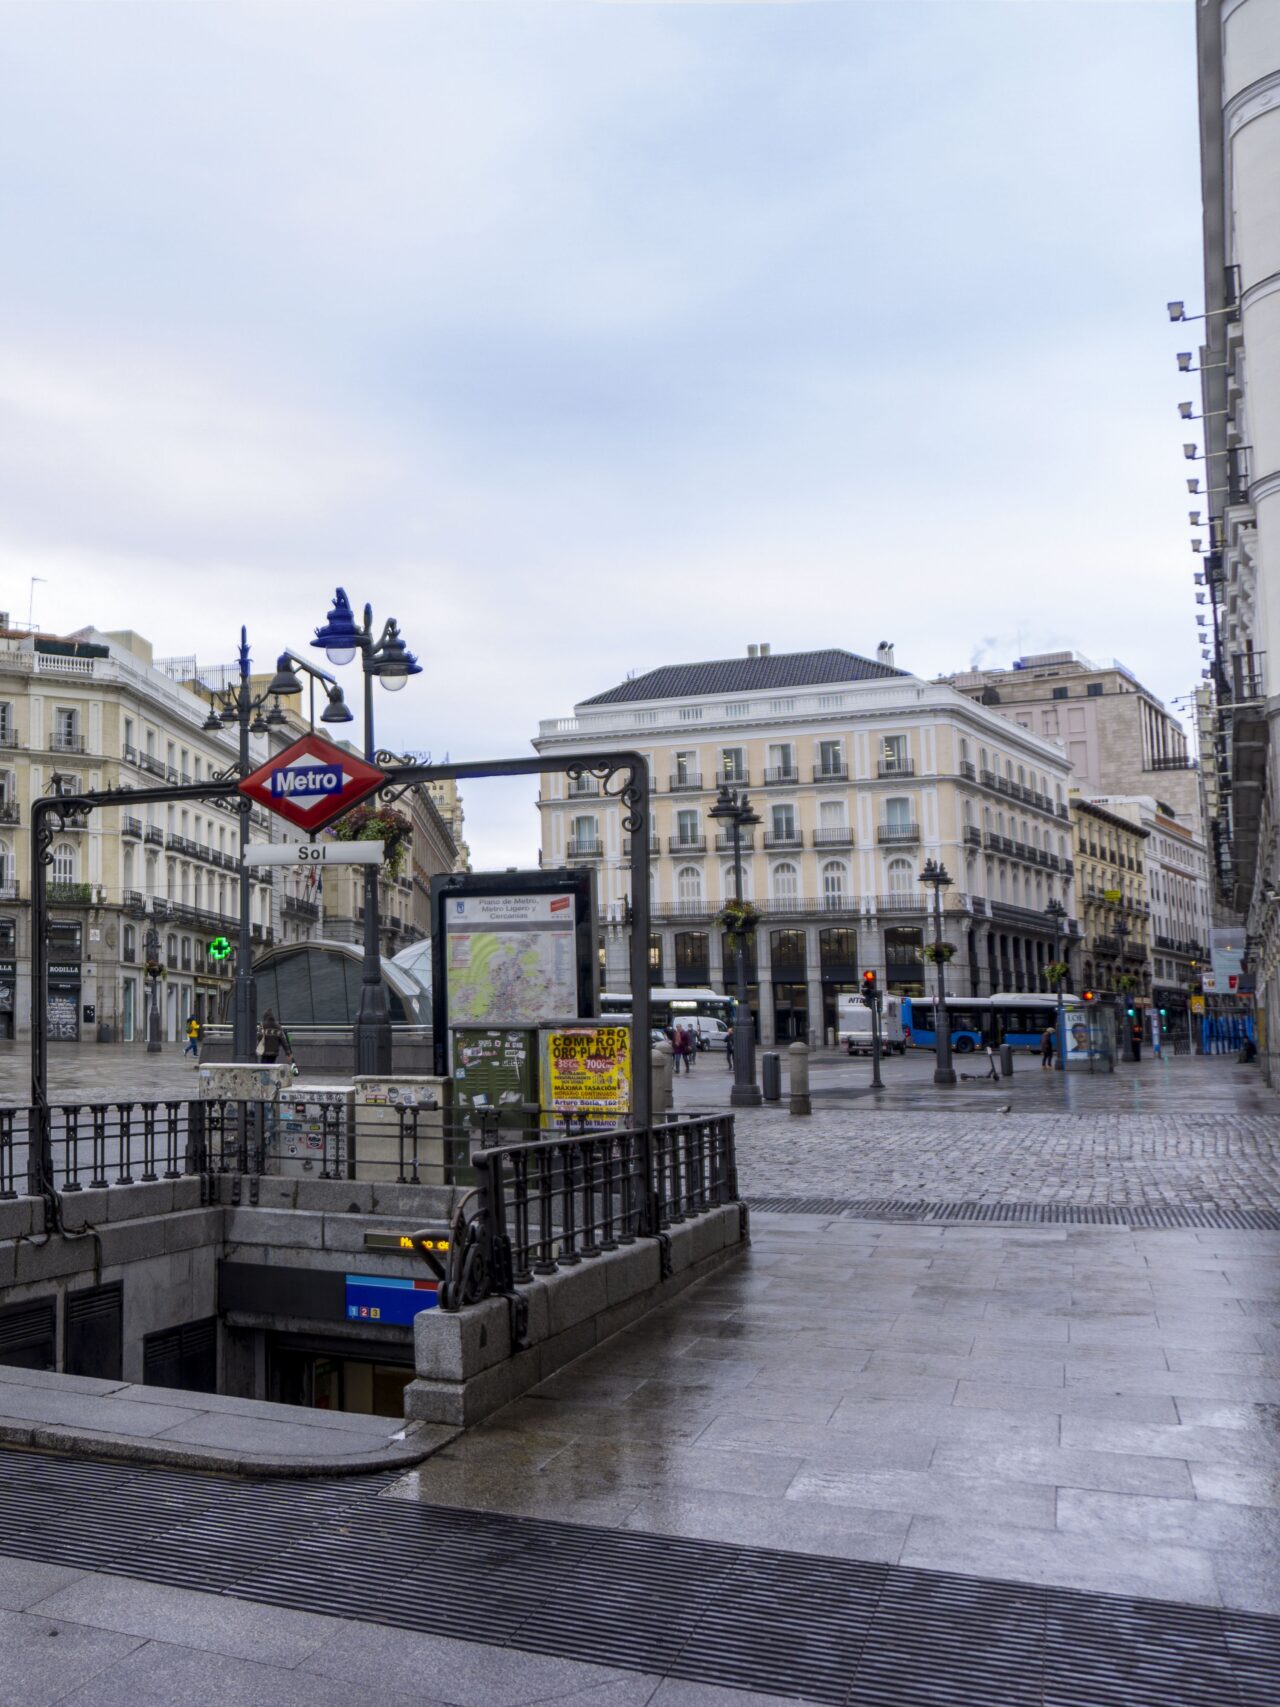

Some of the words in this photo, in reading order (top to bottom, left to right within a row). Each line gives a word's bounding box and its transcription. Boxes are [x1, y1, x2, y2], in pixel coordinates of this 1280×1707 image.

[276, 771, 338, 792] Metro
[297, 846, 326, 860] Sol
[479, 898, 500, 906] Plano
[502, 897, 512, 905] de
[481, 905, 504, 913] Metro
[505, 905, 530, 913] Ligero
[552, 1036, 616, 1047] COMPRO
